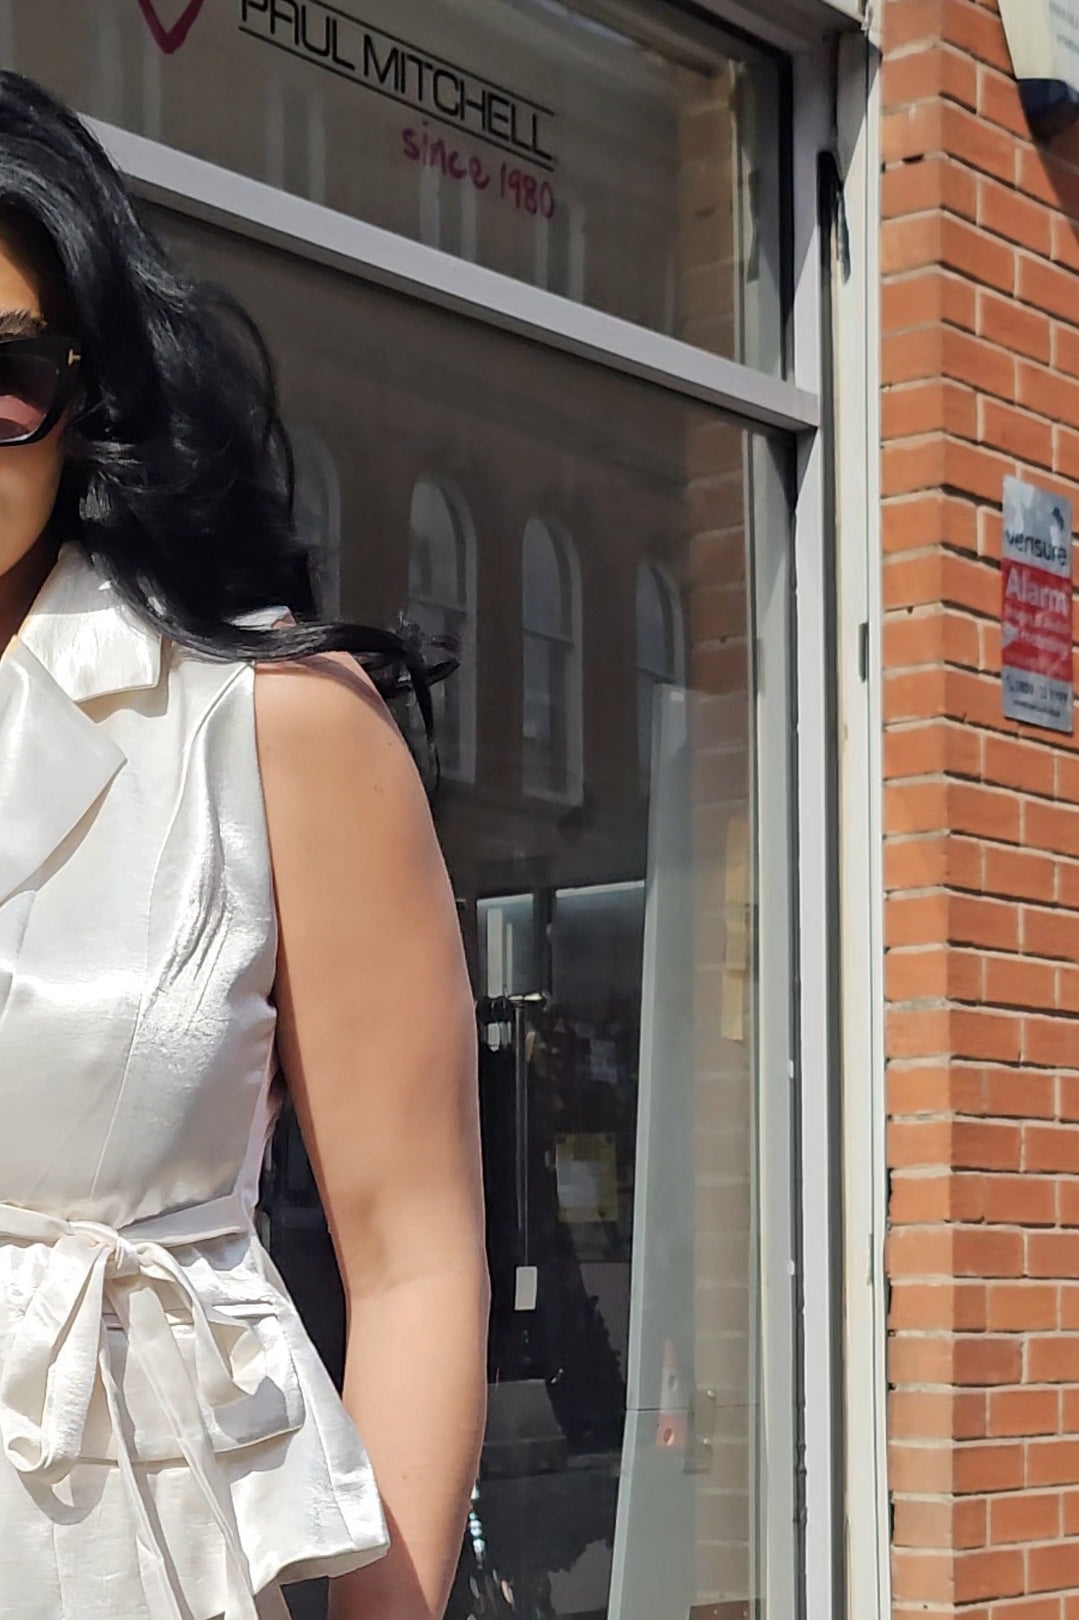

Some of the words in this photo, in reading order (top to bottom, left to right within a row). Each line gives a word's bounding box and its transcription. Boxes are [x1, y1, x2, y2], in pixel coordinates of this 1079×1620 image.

[363, 33, 554, 161] MITCHELL
[401, 121, 491, 191] since
[499, 162, 556, 219] 1980
[1005, 566, 1069, 617] Alarm
